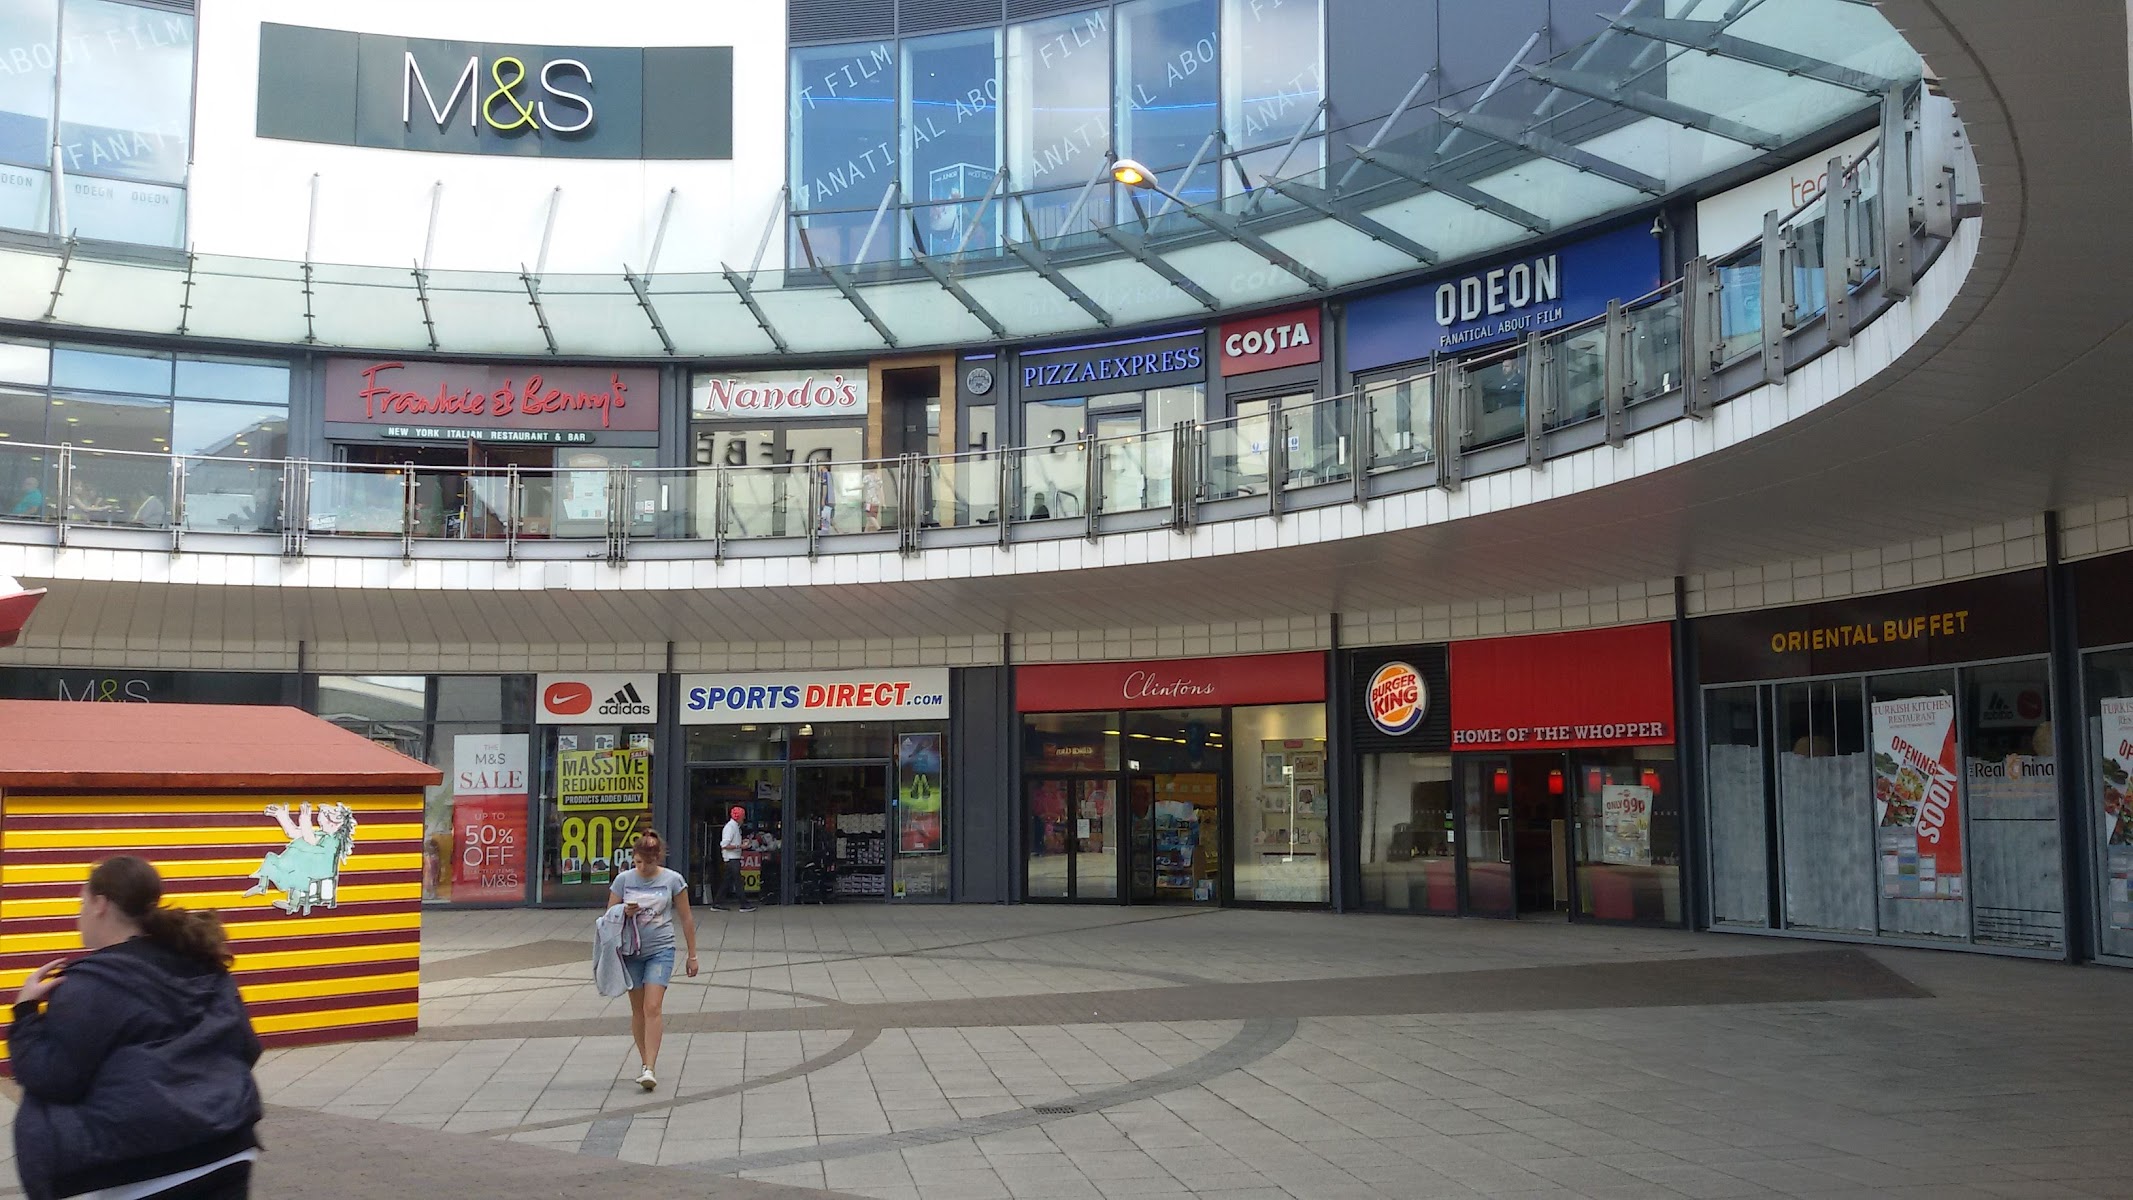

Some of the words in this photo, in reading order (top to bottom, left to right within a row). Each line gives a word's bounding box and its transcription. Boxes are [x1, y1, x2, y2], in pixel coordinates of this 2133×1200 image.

[106, 18, 188, 56] FILM
[1039, 11, 1106, 69] FILM
[824, 44, 893, 97] FILM
[1166, 31, 1217, 87] ABO
[403, 51, 593, 131] M&S
[1435, 254, 1558, 326] ODEON
[1225, 323, 1311, 358] COSTA
[1440, 325, 1493, 347] FANATICAL
[1498, 315, 1531, 334] ABOUT
[1537, 307, 1562, 325] FILM
[1024, 346, 1201, 388] PIZZAEXPRESS
[360, 362, 487, 417] Frankie
[521, 373, 627, 427] Benny's
[706, 375, 858, 412] Nando's
[388, 427, 408, 436] NEW
[415, 428, 440, 437] YORK
[447, 429, 482, 439] ITALIAN
[491, 430, 548, 441] RESTAURANT
[554, 433, 561, 441] &
[568, 433, 586, 442] BAR
[1771, 623, 1878, 653] ORIENTAL
[1883, 610, 1969, 642] BUFFET
[59, 678, 150, 704] M&S
[687, 684, 801, 711] SPORTS
[1122, 670, 1215, 699] Clintons
[1372, 674, 1416, 702] BURGER
[599, 702, 650, 716] adidas
[1374, 686, 1418, 720] KING
[1873, 703, 1910, 715] TURKISH
[1912, 700, 1951, 712] KITCHEN
[1888, 712, 1936, 724] RESTAURANT
[1453, 729, 1501, 743] HOME
[1506, 728, 1530, 742] OF
[1534, 726, 1570, 740] THE
[1574, 722, 1664, 739] WHOPPER
[475, 753, 506, 765] M&S
[563, 754, 645, 777] MASSIVE
[1891, 735, 1937, 776] OPENING
[460, 770, 523, 790] SALE
[1975, 762, 2005, 778] Real
[563, 777, 645, 792] REDUCTIONS
[565, 795, 599, 803] PRODUCTS
[600, 795, 621, 803] ADDED
[623, 794, 641, 802] DAILY
[1606, 800, 1623, 810] ONLY
[1623, 798, 1646, 814] 99p
[1918, 766, 1957, 844] SOON
[475, 813, 488, 821] UP
[492, 812, 505, 820] TO
[465, 825, 513, 845] 50%
[561, 815, 643, 866] 80%
[463, 846, 514, 867] OFF
[614, 848, 634, 867] OF
[481, 874, 518, 888] M&S
